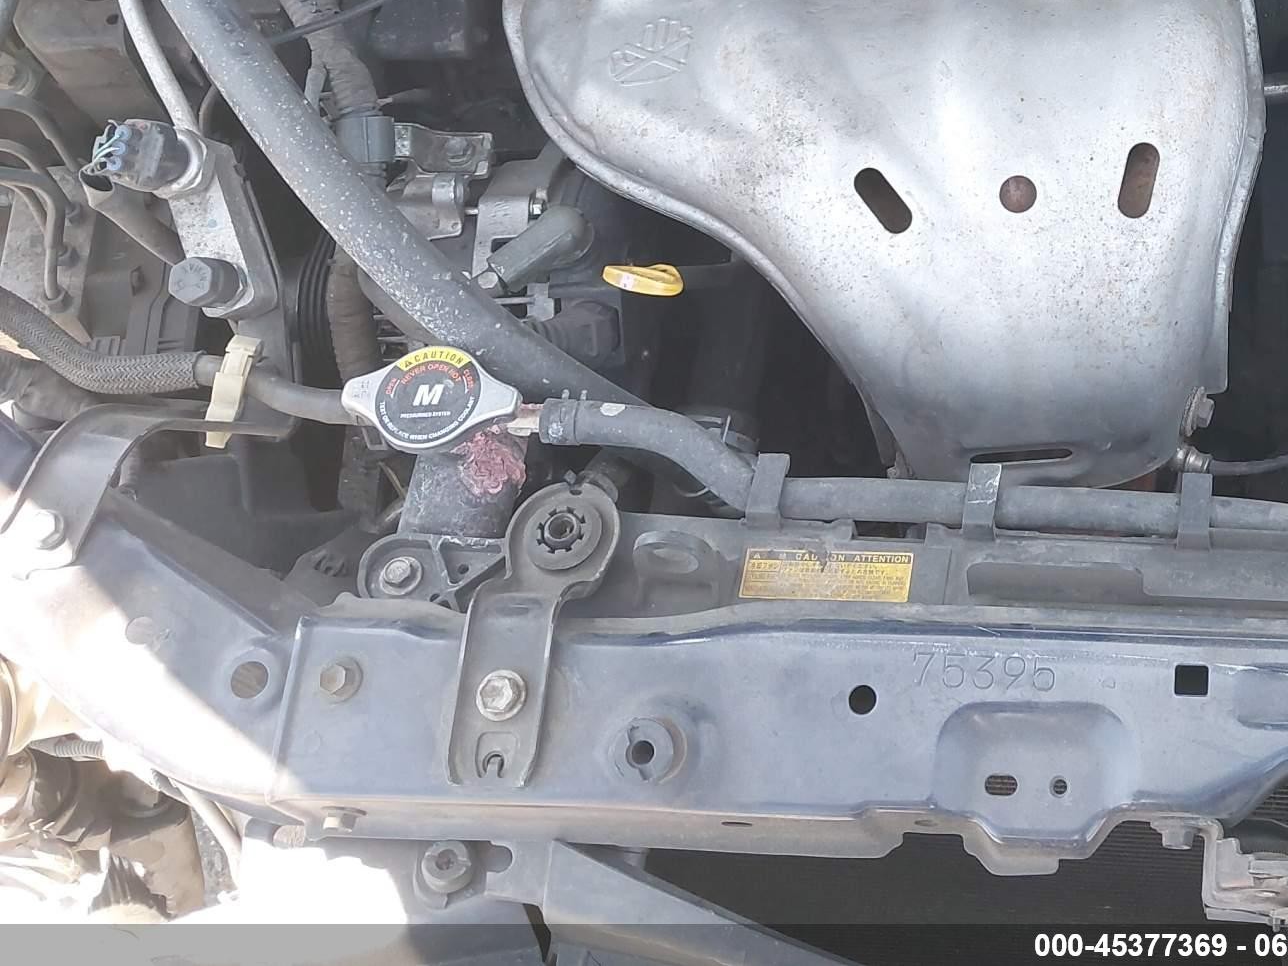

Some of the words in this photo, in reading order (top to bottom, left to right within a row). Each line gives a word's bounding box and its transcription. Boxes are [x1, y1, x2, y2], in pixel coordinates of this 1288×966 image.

[414, 351, 463, 365] CAUTION
[401, 366, 426, 385] NEVER
[427, 363, 449, 372] OPEN
[448, 368, 462, 382] HOT
[412, 384, 445, 406] M
[854, 554, 909, 563] ATTENTION
